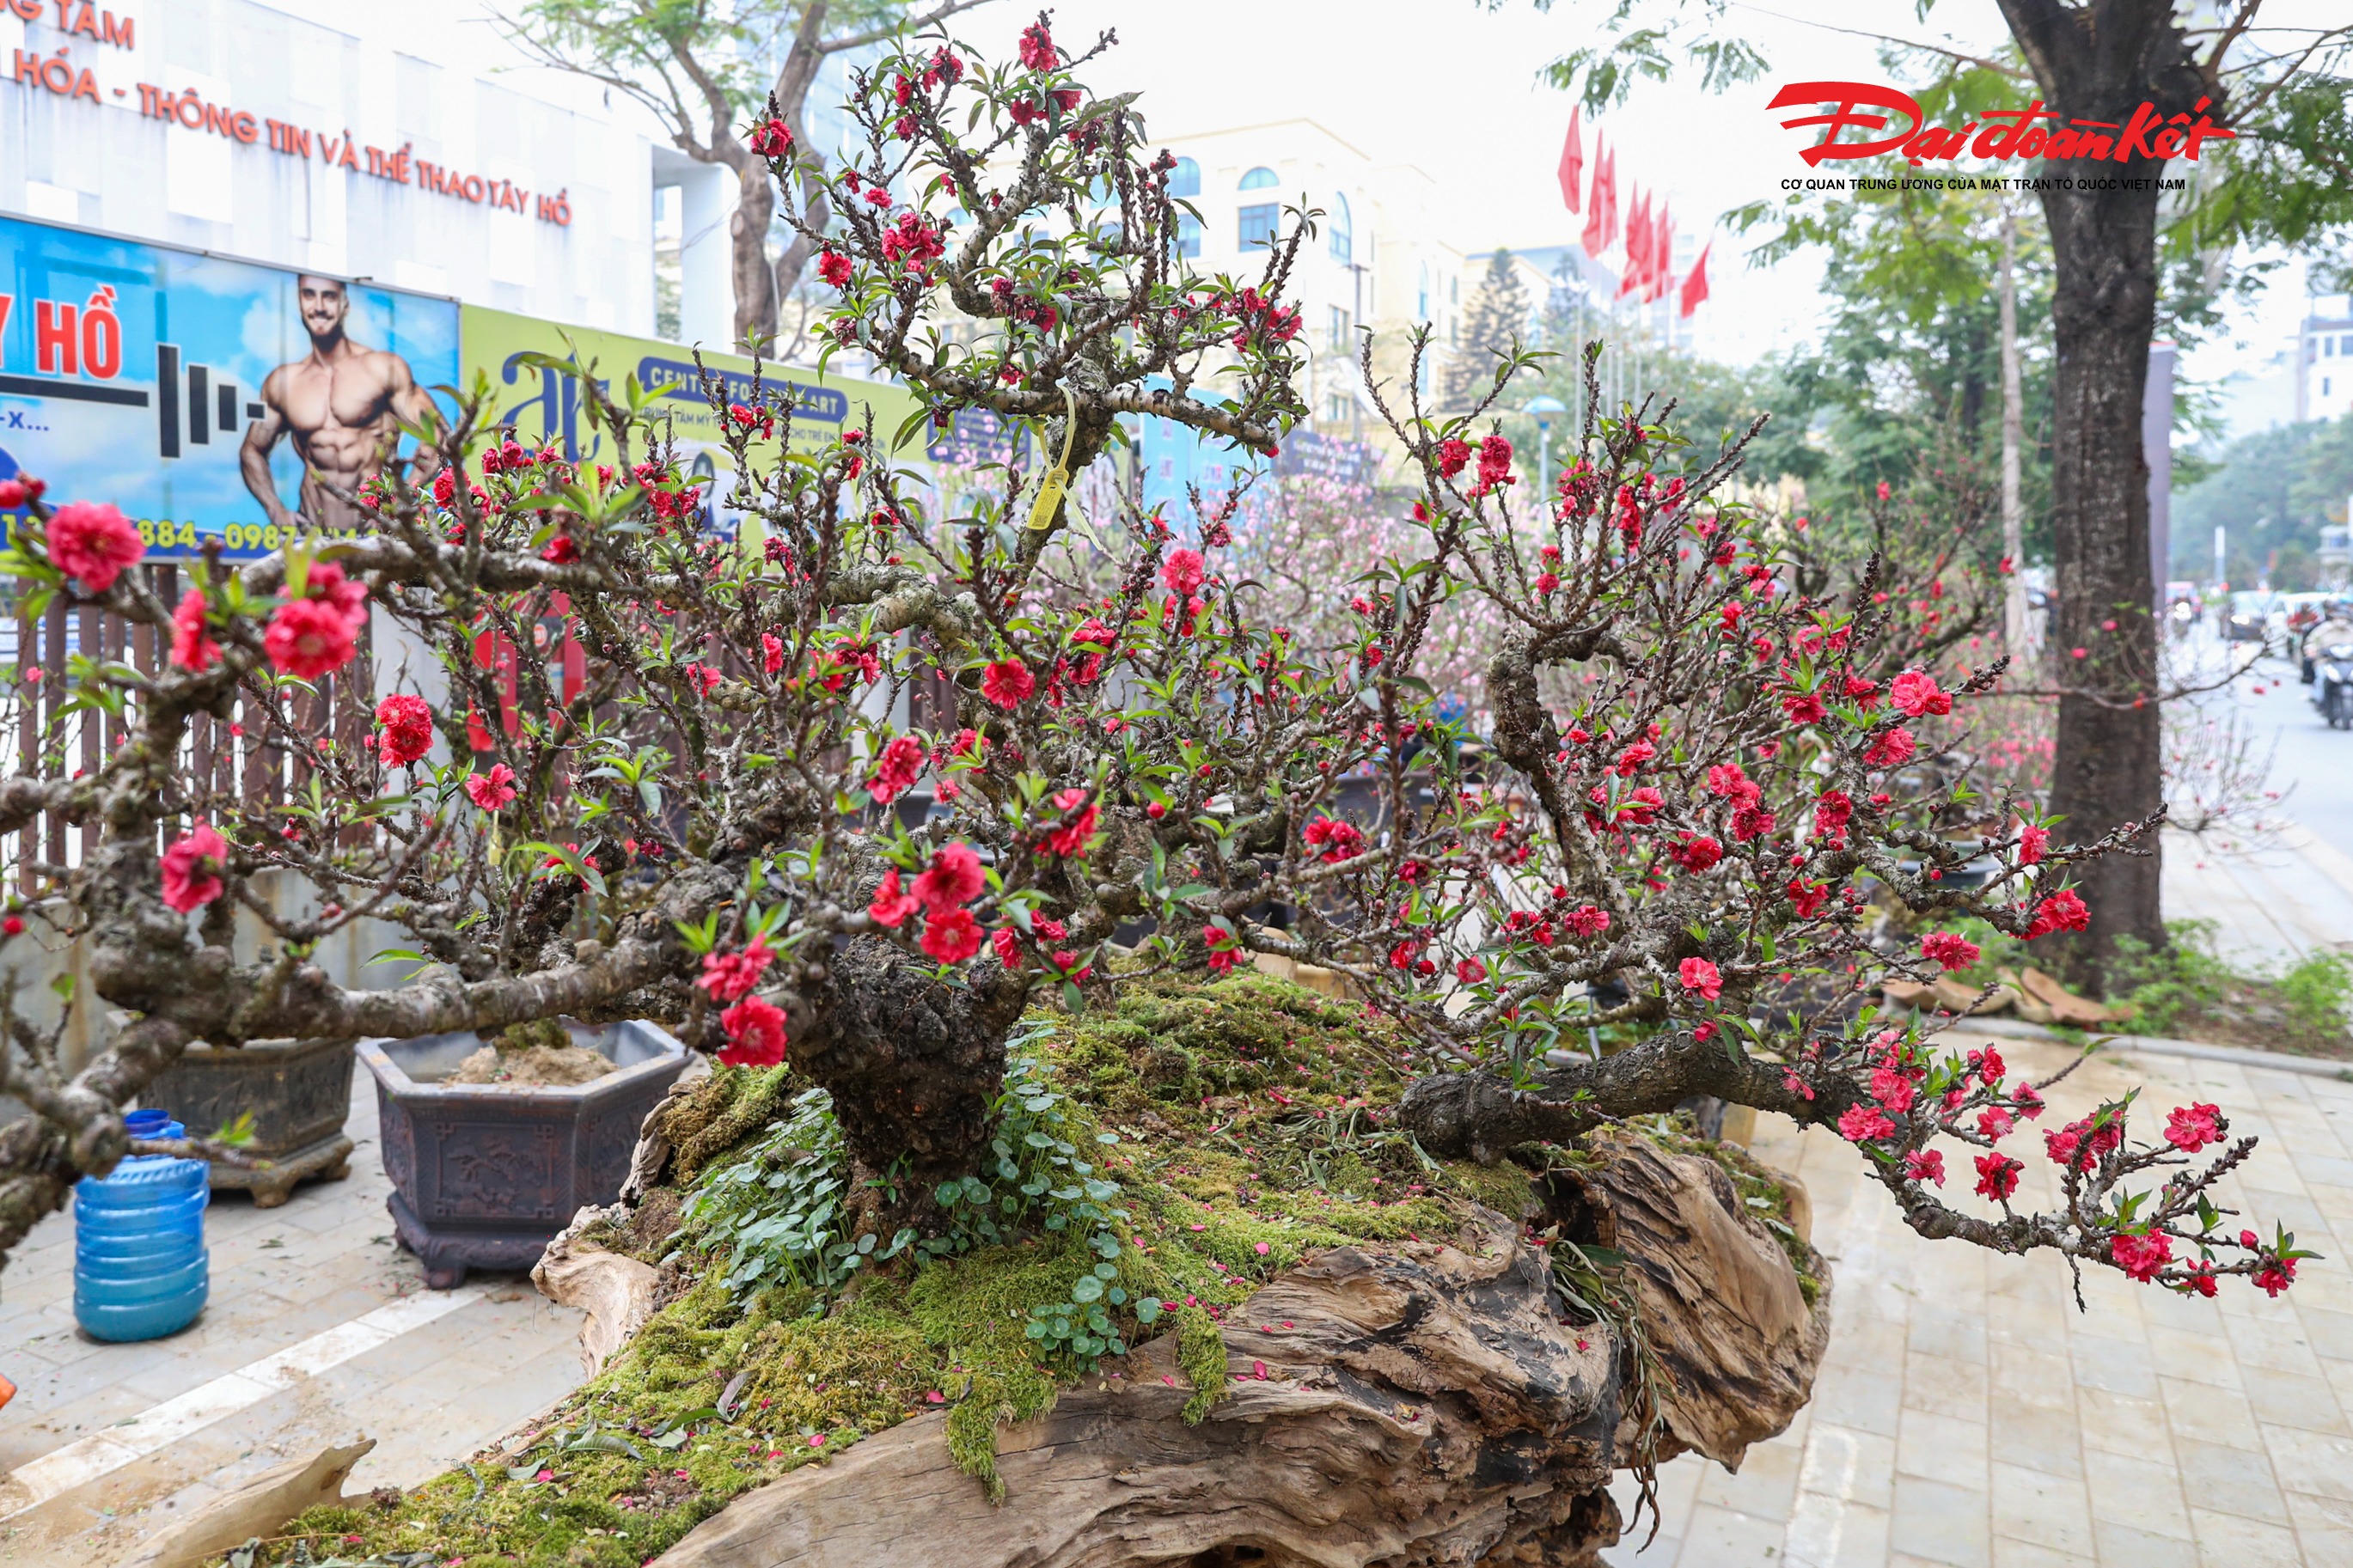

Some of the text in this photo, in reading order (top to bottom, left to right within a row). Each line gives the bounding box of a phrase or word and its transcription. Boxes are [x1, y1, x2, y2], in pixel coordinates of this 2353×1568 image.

[15, 46, 101, 104] HÓA
[137, 82, 260, 144] THÔNG
[266, 119, 311, 159] TIN
[318, 129, 361, 171] VÀ
[416, 160, 486, 204] THAO
[488, 178, 529, 214] TÂY
[36, 284, 120, 380] HỒ
[809, 395, 838, 415] ART
[137, 519, 198, 548] 884
